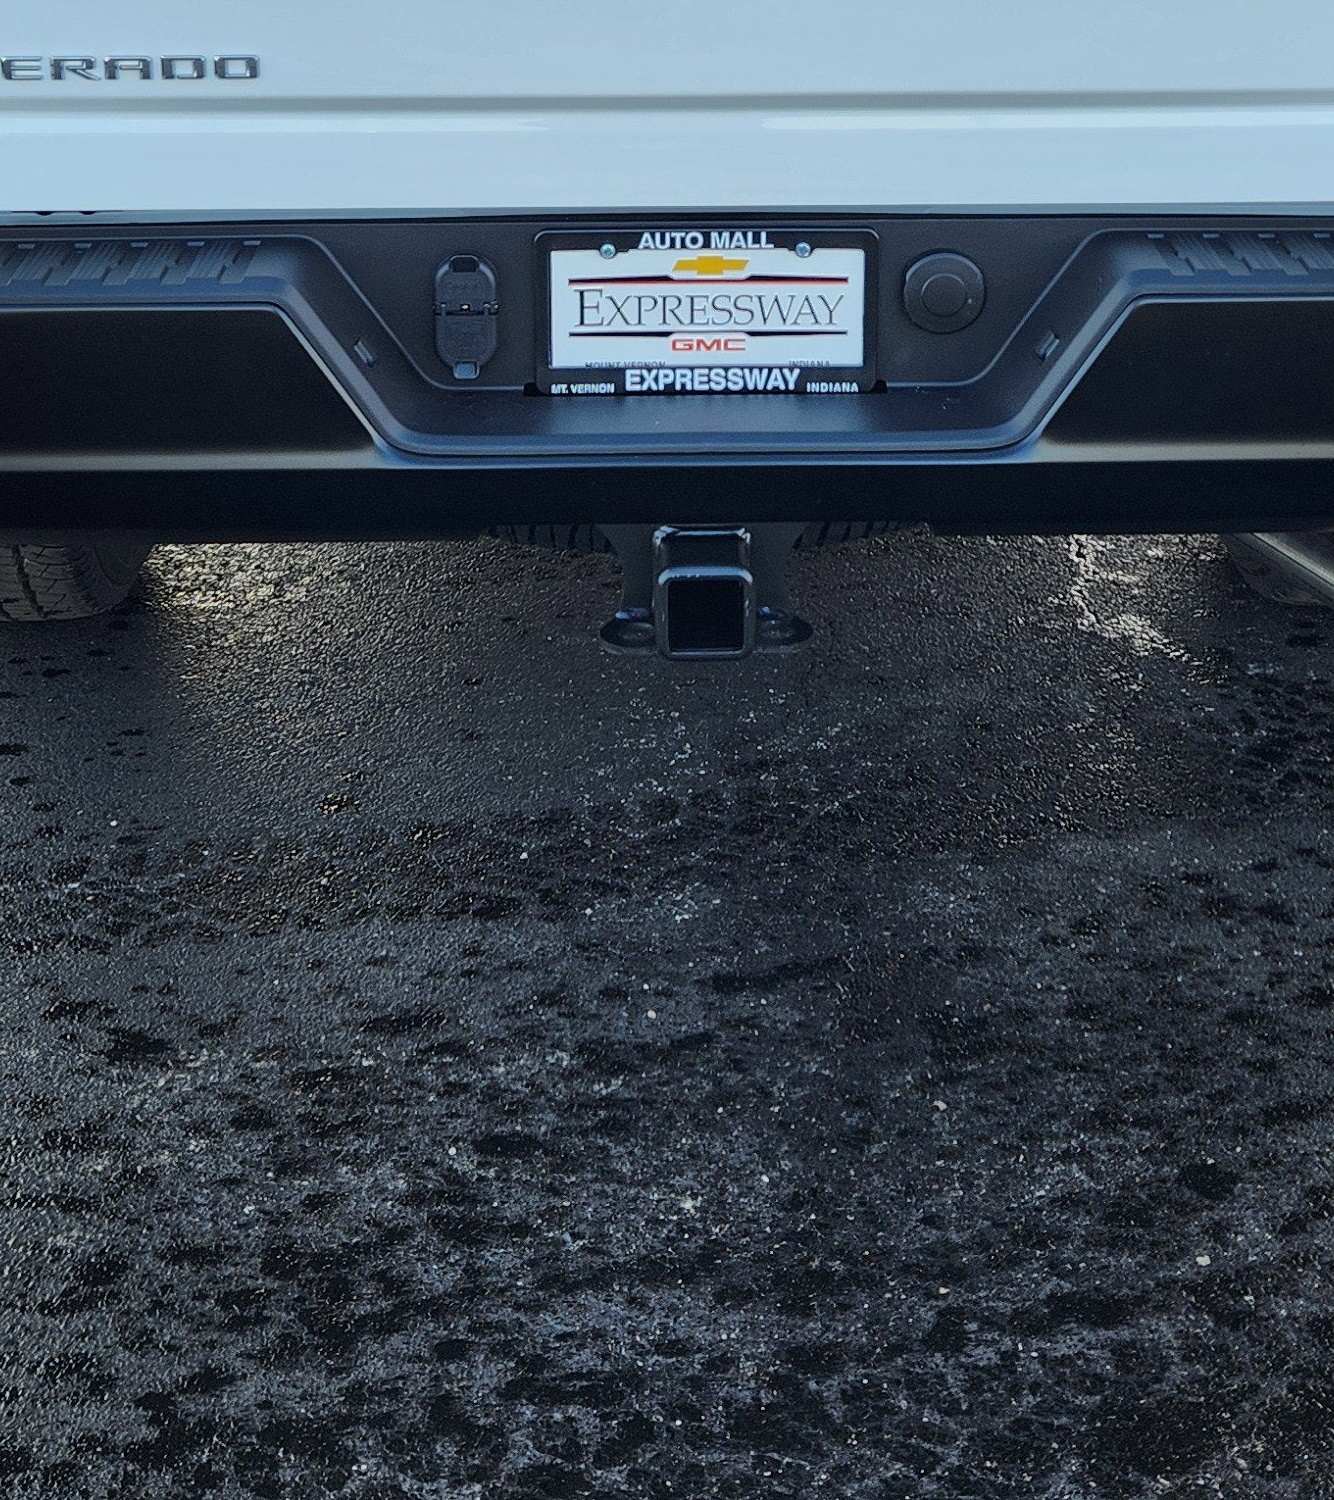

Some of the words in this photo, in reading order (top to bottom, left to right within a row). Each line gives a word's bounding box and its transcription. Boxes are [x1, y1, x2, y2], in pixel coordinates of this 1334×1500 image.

[638, 231, 704, 250] AUTO
[710, 231, 775, 249] MALL
[671, 338, 747, 352] GMC
[625, 368, 801, 392] EXPRESSWAY
[550, 383, 569, 394] MT.
[570, 383, 615, 394] VERNON
[806, 382, 859, 393] INDIANA
